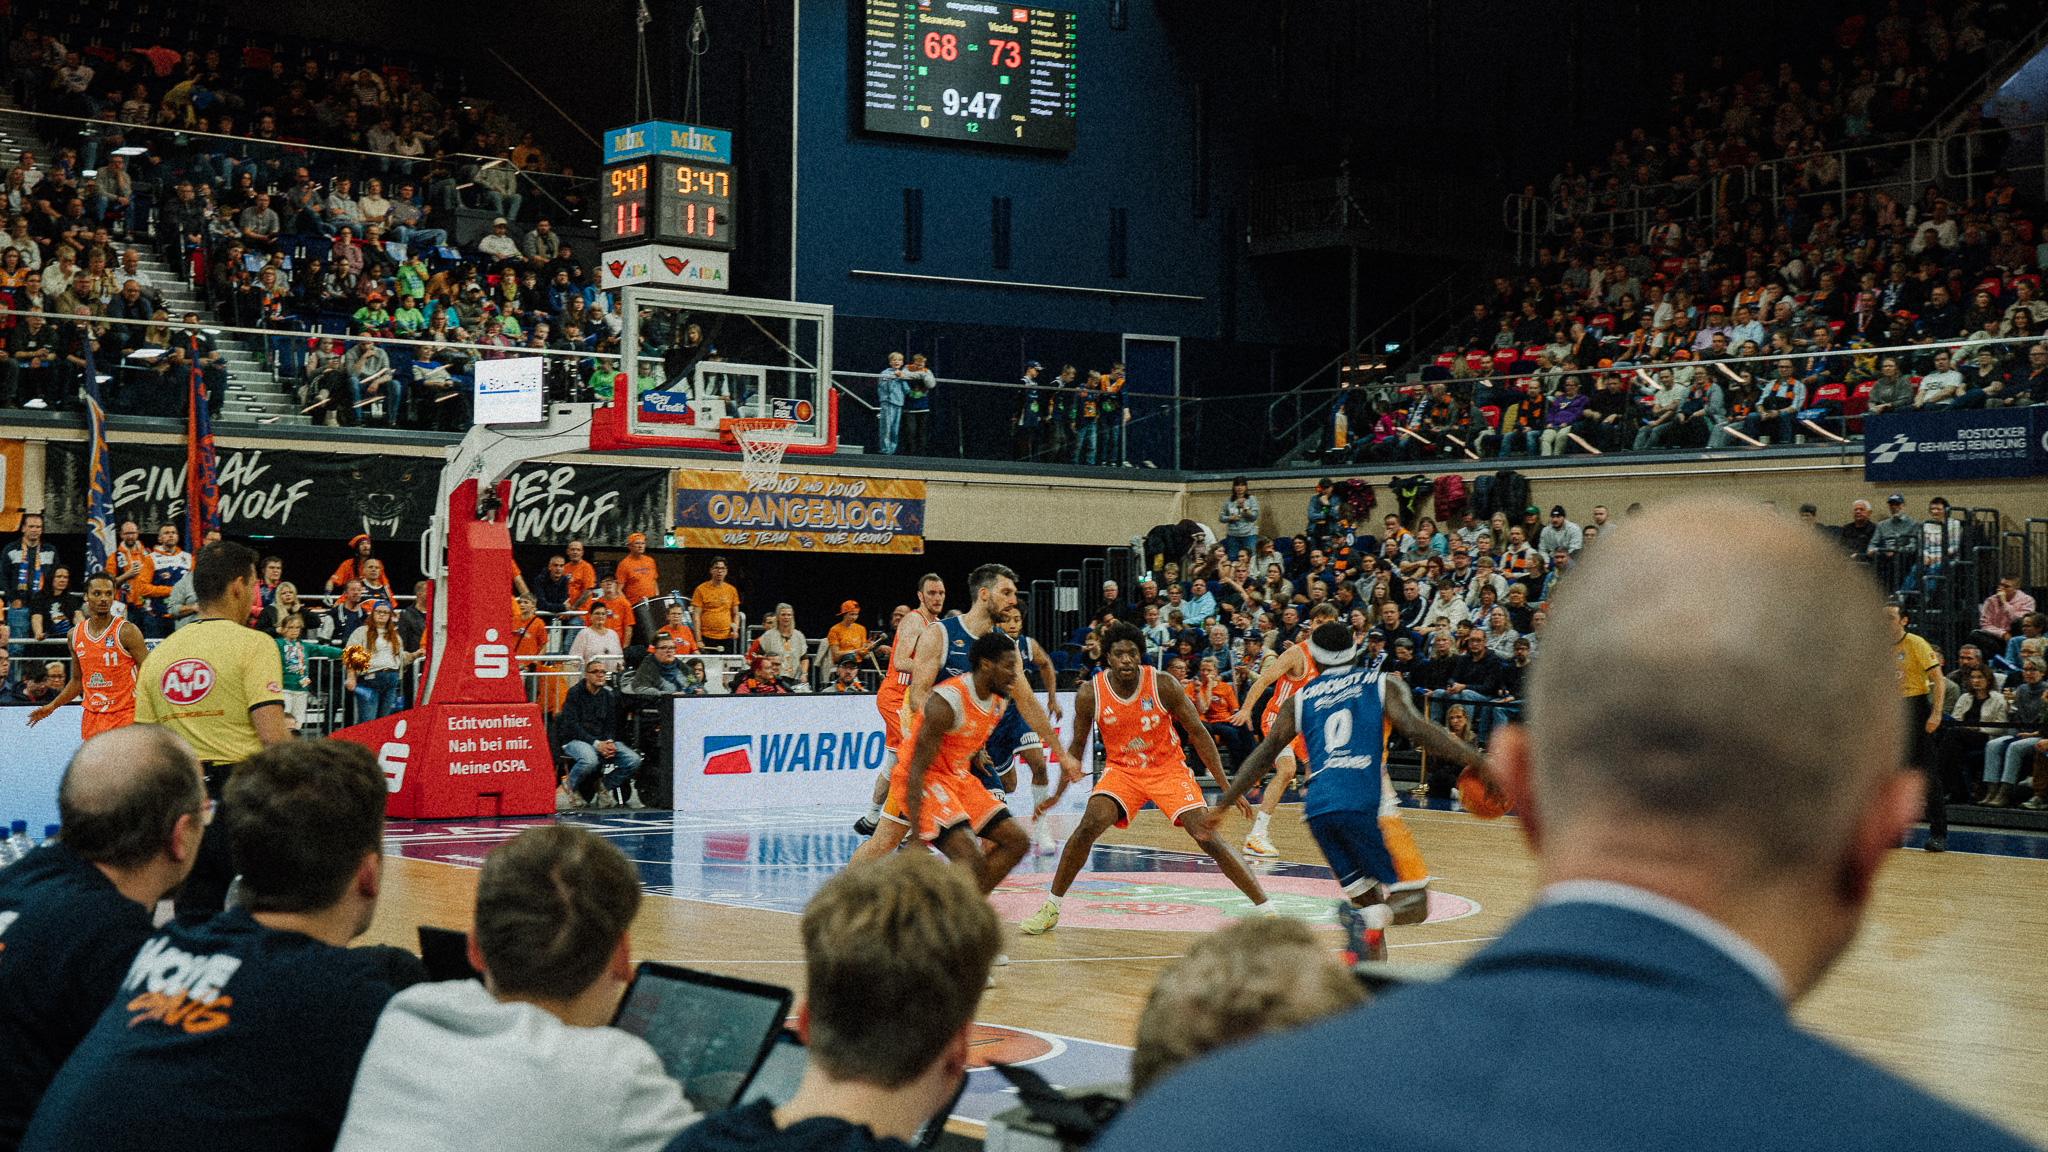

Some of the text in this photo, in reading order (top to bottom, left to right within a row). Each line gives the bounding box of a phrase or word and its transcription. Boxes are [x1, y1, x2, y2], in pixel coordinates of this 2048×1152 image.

[919, 14, 966, 28] Seawolves
[988, 22, 1018, 34] Vechta
[924, 32, 958, 61] 68
[988, 39, 1022, 68] 73
[942, 88, 1002, 120] 9:47
[920, 116, 930, 128] 0
[966, 122, 978, 132] 12
[1014, 126, 1022, 138] 1
[612, 164, 647, 196] 9:47
[677, 166, 728, 197] 9:47
[618, 202, 638, 235] 11
[687, 204, 714, 236] 11
[626, 264, 648, 278] AIDA
[689, 267, 722, 280] AIDA
[656, 402, 685, 412] Credit
[774, 410, 792, 418] BBL
[1957, 426, 2026, 439] ROSTOCKER
[1918, 440, 1966, 452] GEHWEG
[1966, 438, 2026, 450] REINIGUNG
[747, 476, 800, 494] PROUD
[826, 480, 866, 498] LOUD
[516, 490, 620, 542] WOLF
[708, 494, 904, 530] ORANGEBLOCK
[722, 530, 893, 547] ONE TEAM ONE CROWD
[102, 651, 118, 666] 11
[448, 714, 532, 730] Echt von hier.
[1324, 708, 1352, 753] 0
[448, 736, 532, 752] Nah bei mir.
[449, 760, 530, 776] Meine OSPA.
